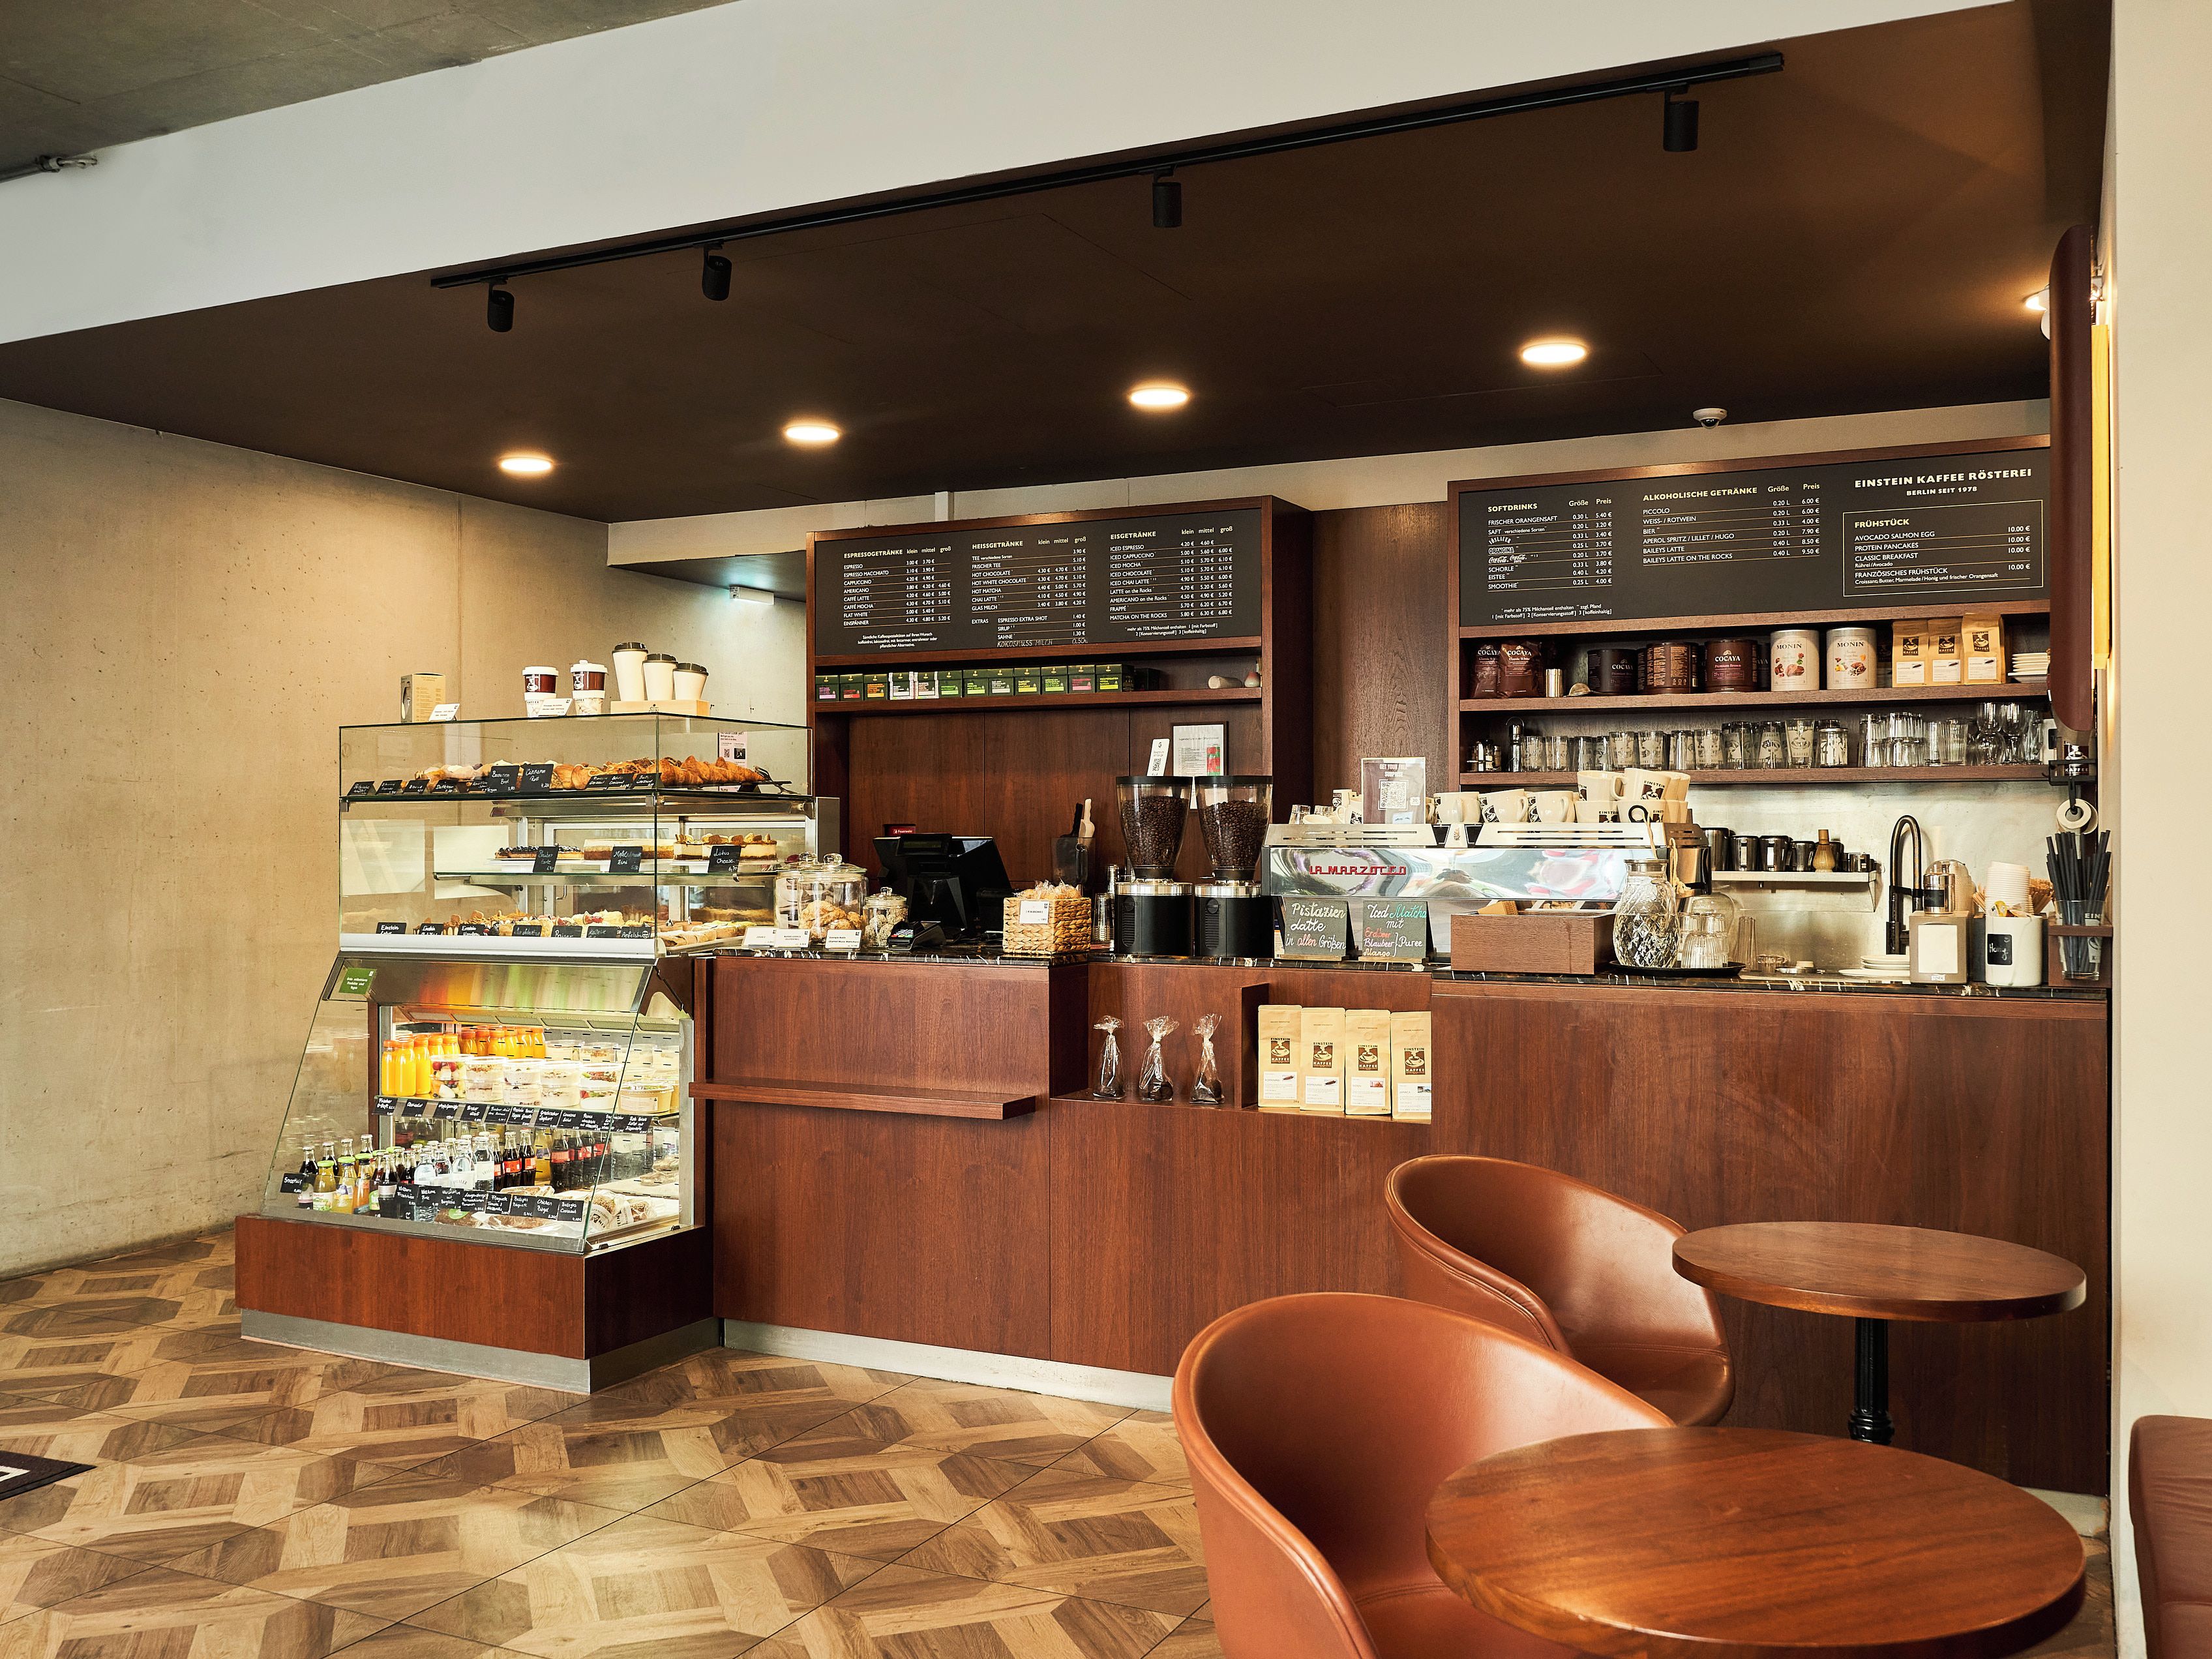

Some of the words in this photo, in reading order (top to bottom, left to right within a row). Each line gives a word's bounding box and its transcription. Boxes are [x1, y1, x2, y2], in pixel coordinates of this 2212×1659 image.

[1855, 477, 1912, 488] EINSTEIN
[1917, 473, 1964, 484] KAFFEE
[1969, 469, 2031, 480] RÖSTEREI
[1643, 491, 1708, 501] ALKOHOLISCHE
[1710, 487, 1757, 496] GETRÄNKE
[1488, 503, 1537, 512] SOFTDRINKS
[1855, 518, 1909, 528] FRÜHSTÜCK
[1111, 531, 1156, 540] EISGETRÄNKE
[972, 541, 1023, 549] HEISSGETRÄNKE
[844, 549, 903, 558] ESPRESSOGETRÄNKE
[1855, 570, 1907, 578] FRANZÖSISCHES
[1909, 567, 1948, 575] FRÜHSTÜCK
[1291, 903, 1346, 919] Pistazien
[1368, 904, 1389, 919] Iced
[1389, 905, 1427, 919] Matcha
[1386, 918, 1404, 929] mit
[1365, 927, 1391, 938] Erdbeer
[1286, 935, 1294, 946] in
[1297, 934, 1317, 946] allen
[1319, 934, 1346, 952] Größen
[1364, 938, 1395, 948] Blaubeer
[1398, 937, 1423, 947] Puree
